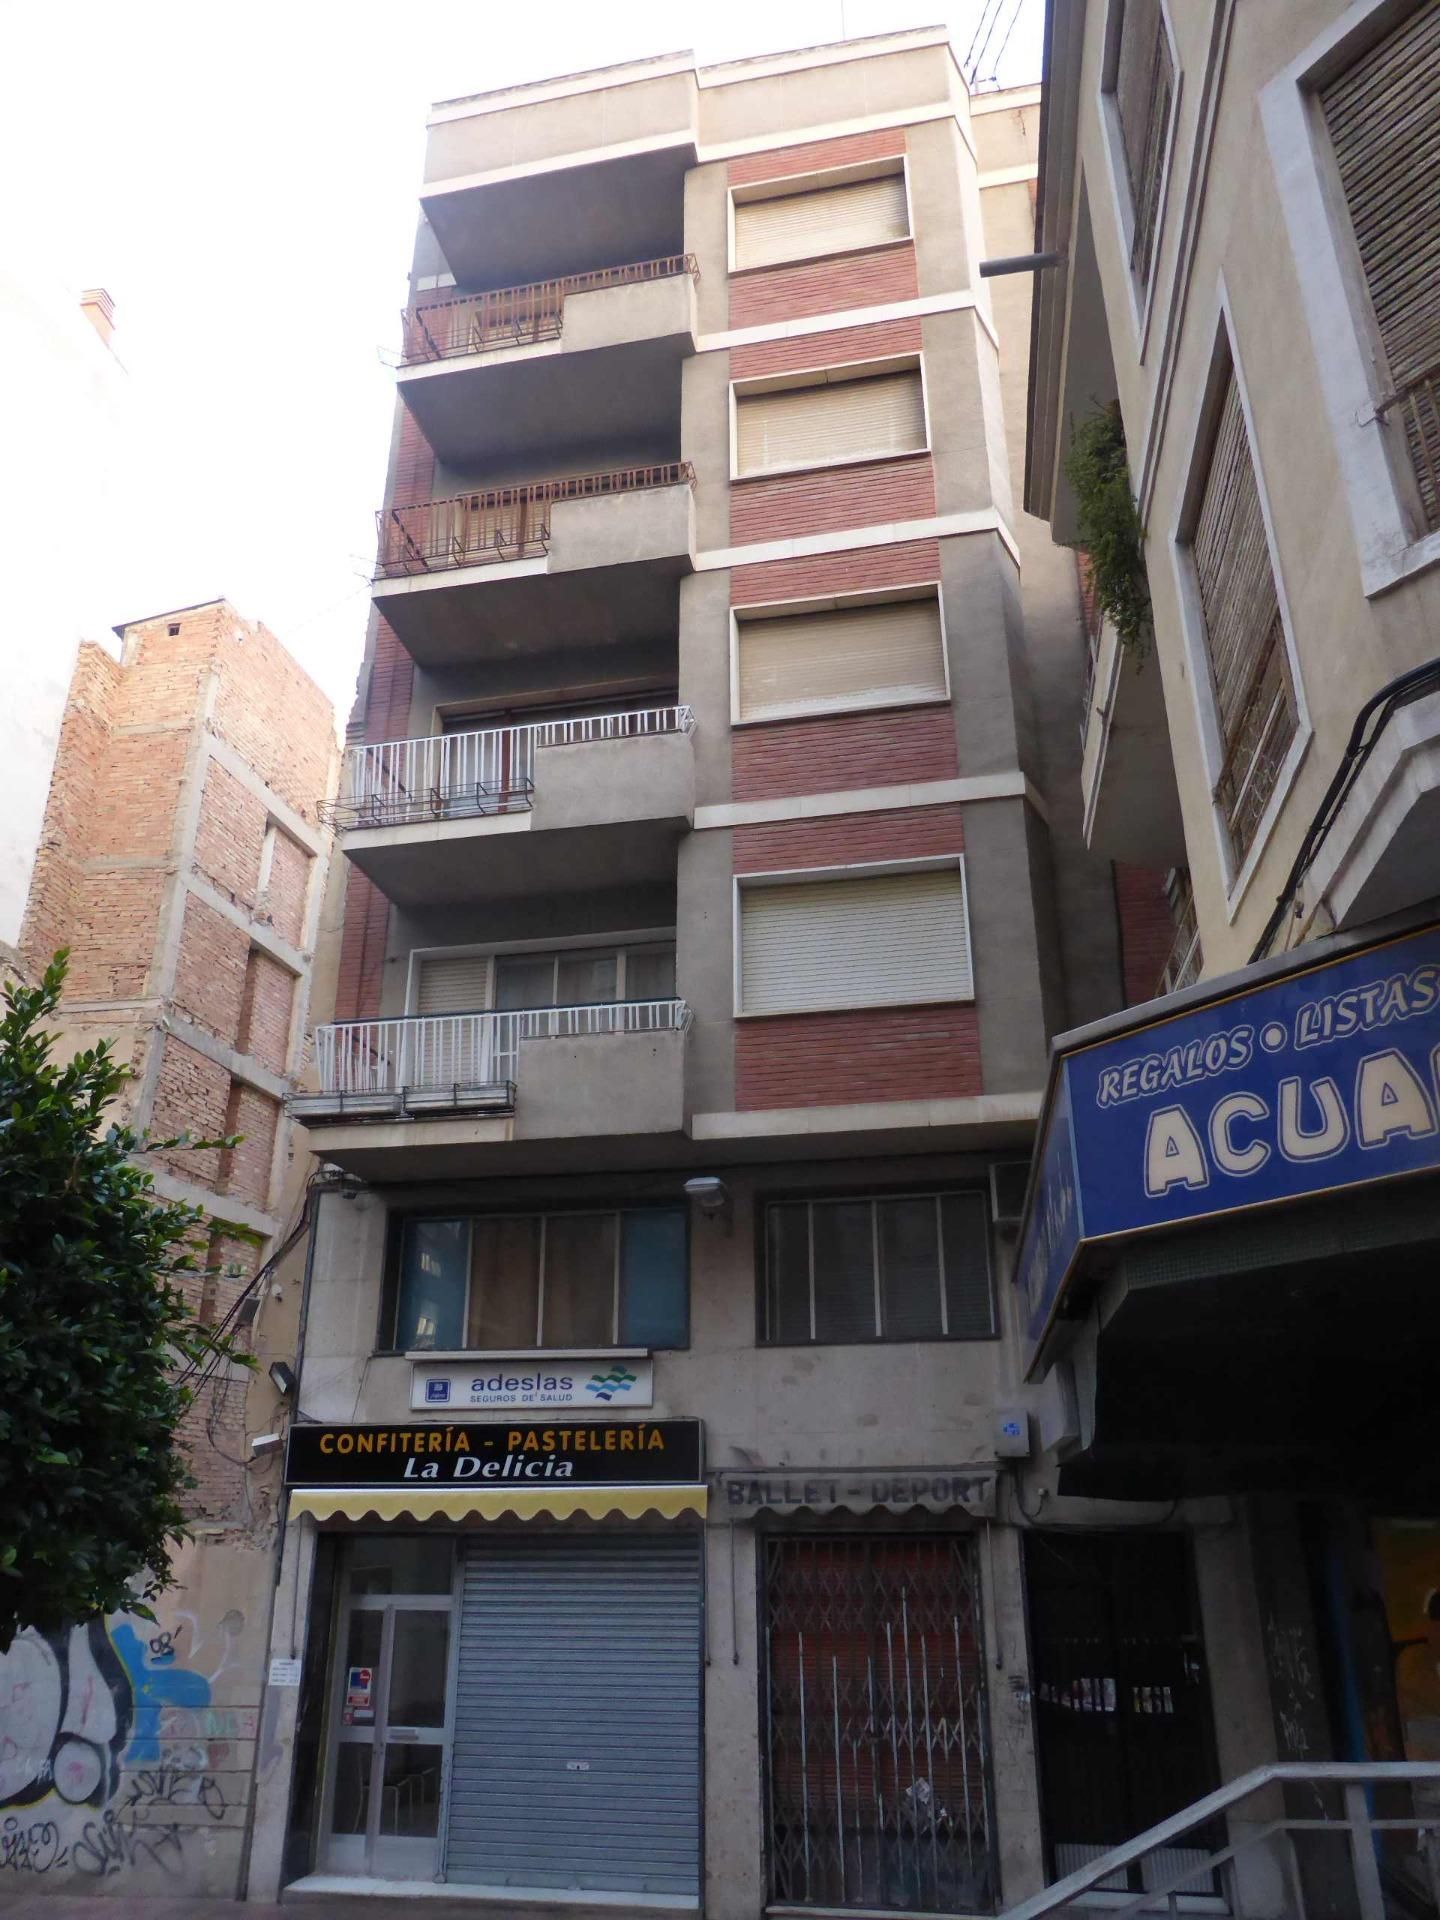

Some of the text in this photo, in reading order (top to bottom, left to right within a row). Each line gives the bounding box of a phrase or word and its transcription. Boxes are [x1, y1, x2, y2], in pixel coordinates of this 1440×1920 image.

[1098, 966, 1440, 1107] REGALOS LISTAS
[1144, 1045, 1440, 1197] ACUA
[471, 1372, 573, 1392] adeslas
[470, 1393, 573, 1403] SEGUROS DE SALUD
[319, 1427, 470, 1454] CONFITERÍA
[507, 1423, 665, 1451] PASTELERÍA
[403, 1455, 573, 1479] La Delicia
[727, 1479, 840, 1505] BALLET
[871, 1476, 993, 1504] DEPORT
